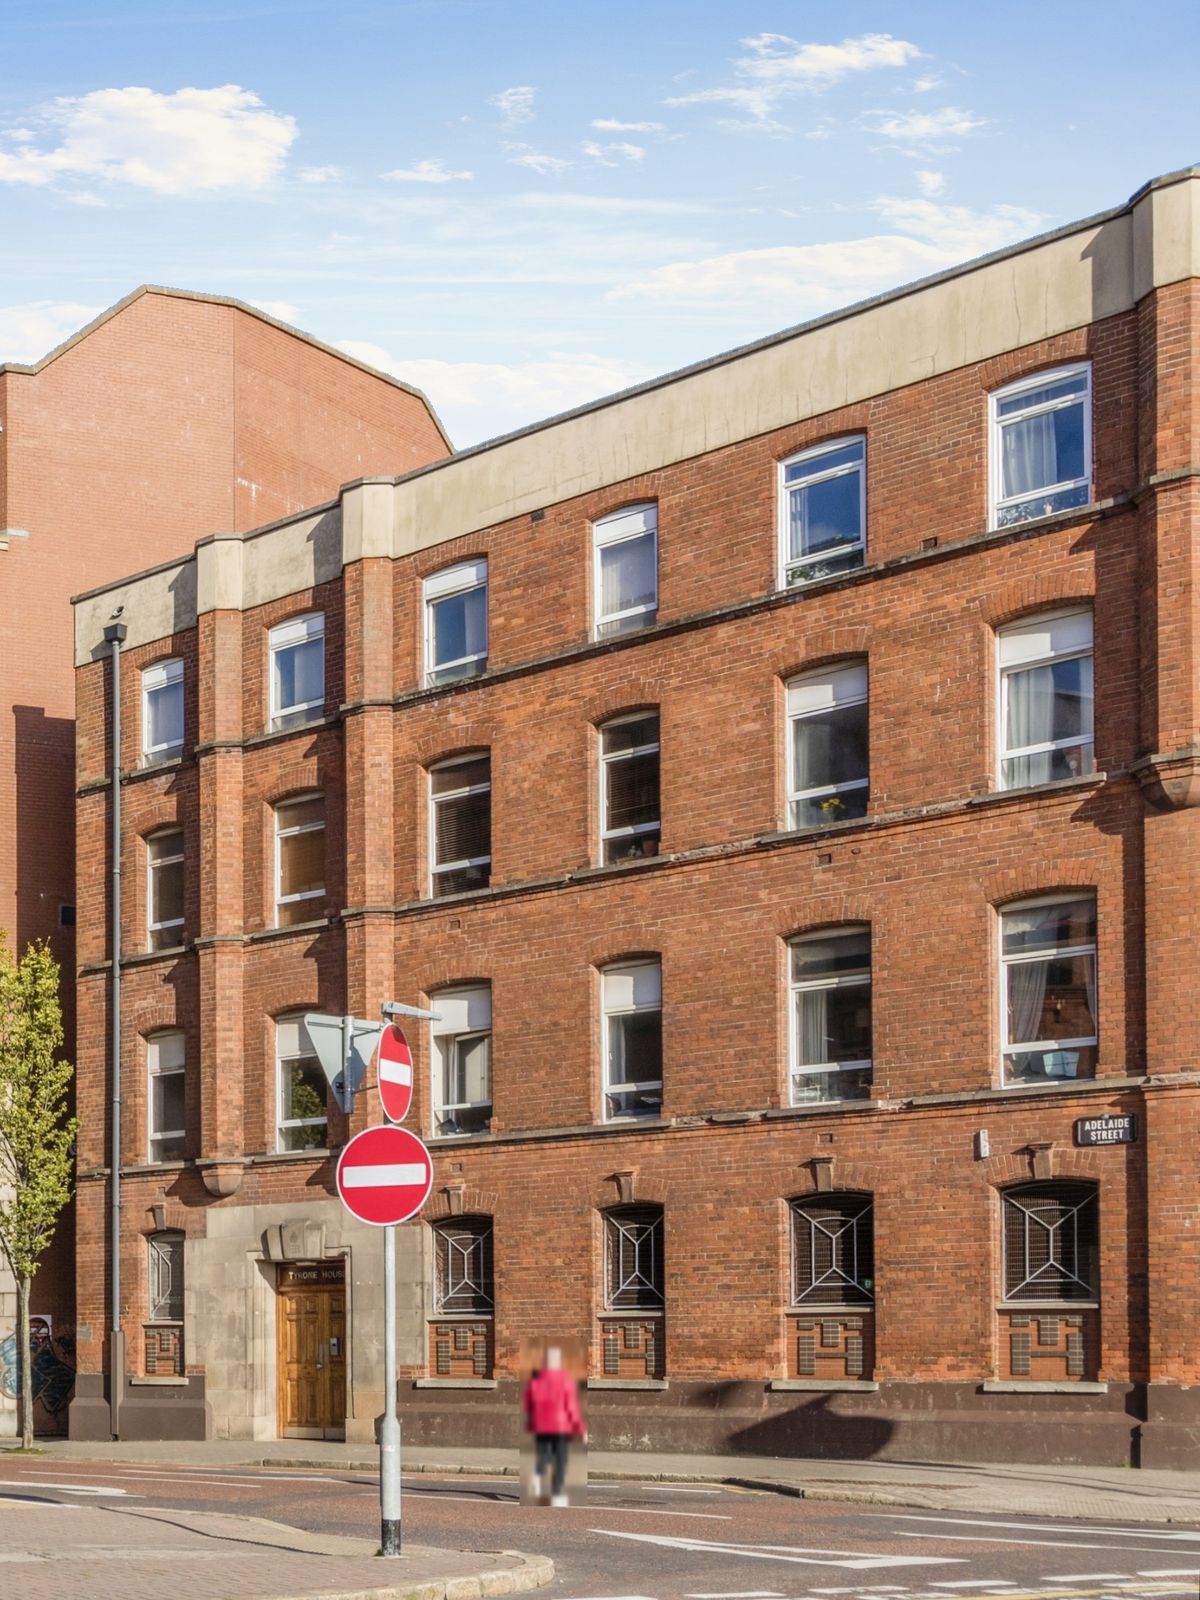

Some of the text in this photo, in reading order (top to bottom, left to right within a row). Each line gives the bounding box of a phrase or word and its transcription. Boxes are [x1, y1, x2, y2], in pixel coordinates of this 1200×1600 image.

[1084, 1118, 1130, 1131] ADELAIDE
[1090, 1129, 1124, 1140] STREET
[288, 1270, 345, 1280] TYRONE HOUS
